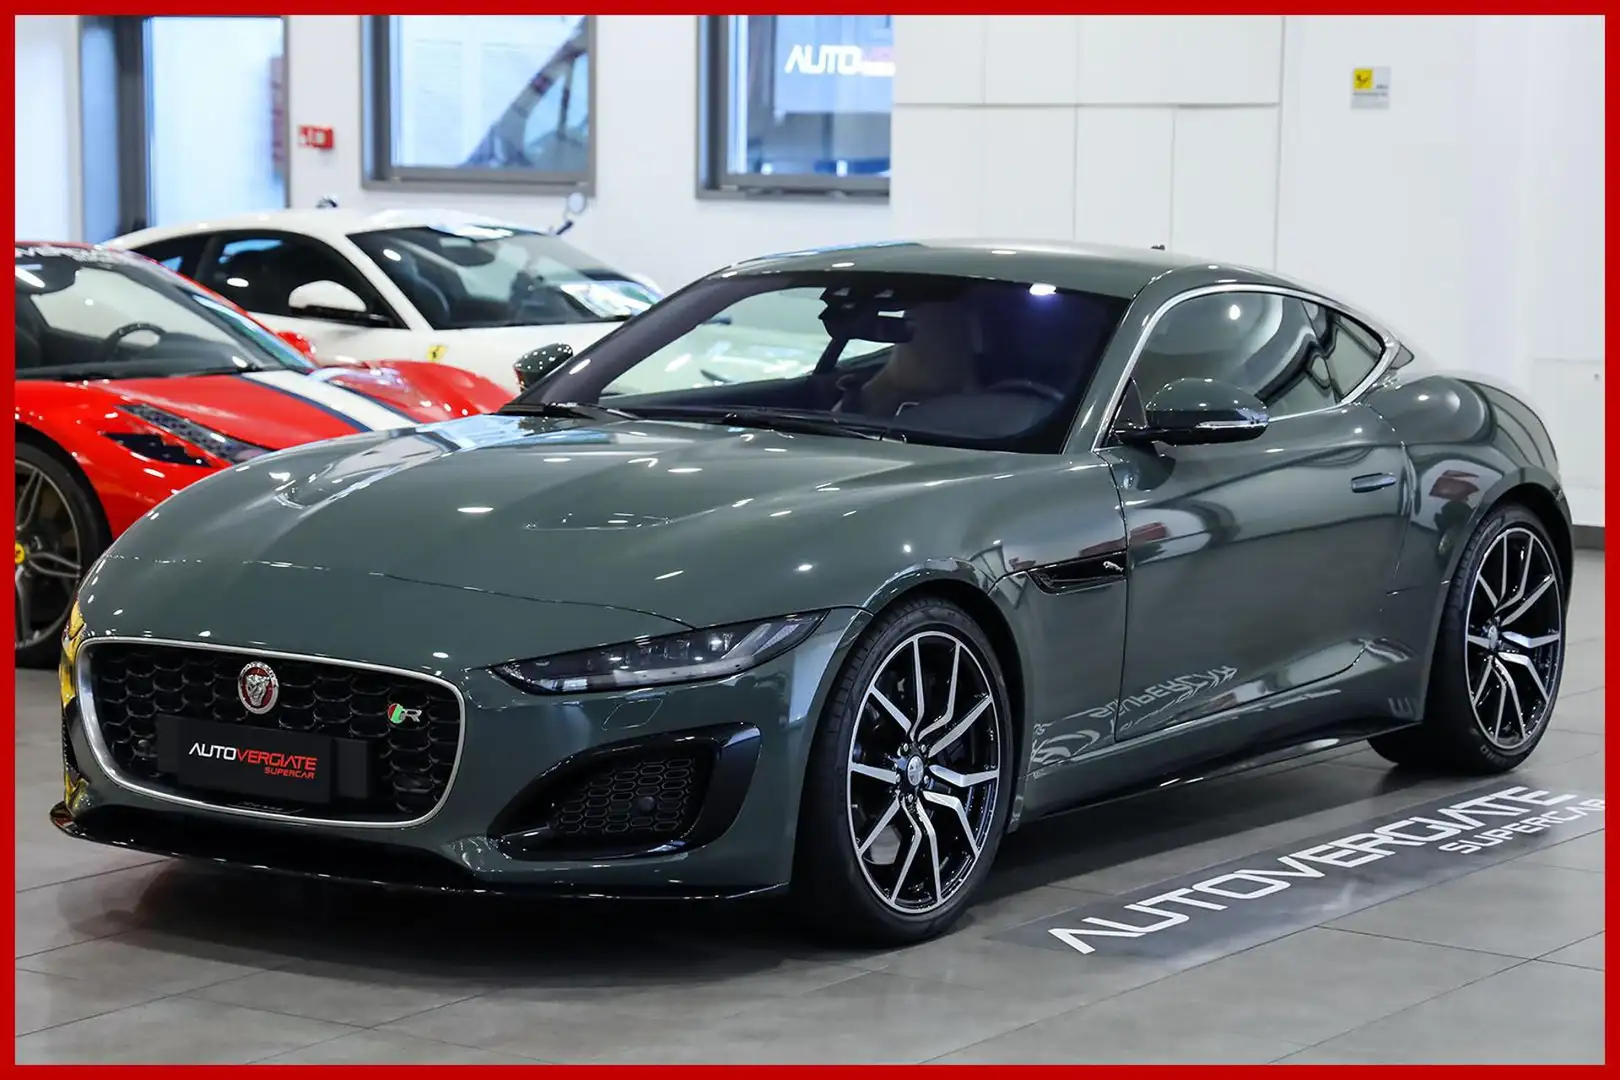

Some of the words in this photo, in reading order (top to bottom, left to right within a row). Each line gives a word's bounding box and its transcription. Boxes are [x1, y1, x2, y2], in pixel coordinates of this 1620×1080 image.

[784, 43, 874, 76] AUTO
[188, 742, 318, 771] AUTOVERGIATE
[264, 766, 315, 779] SUPERCAR
[1048, 786, 1578, 955] AUTOVERGIATE
